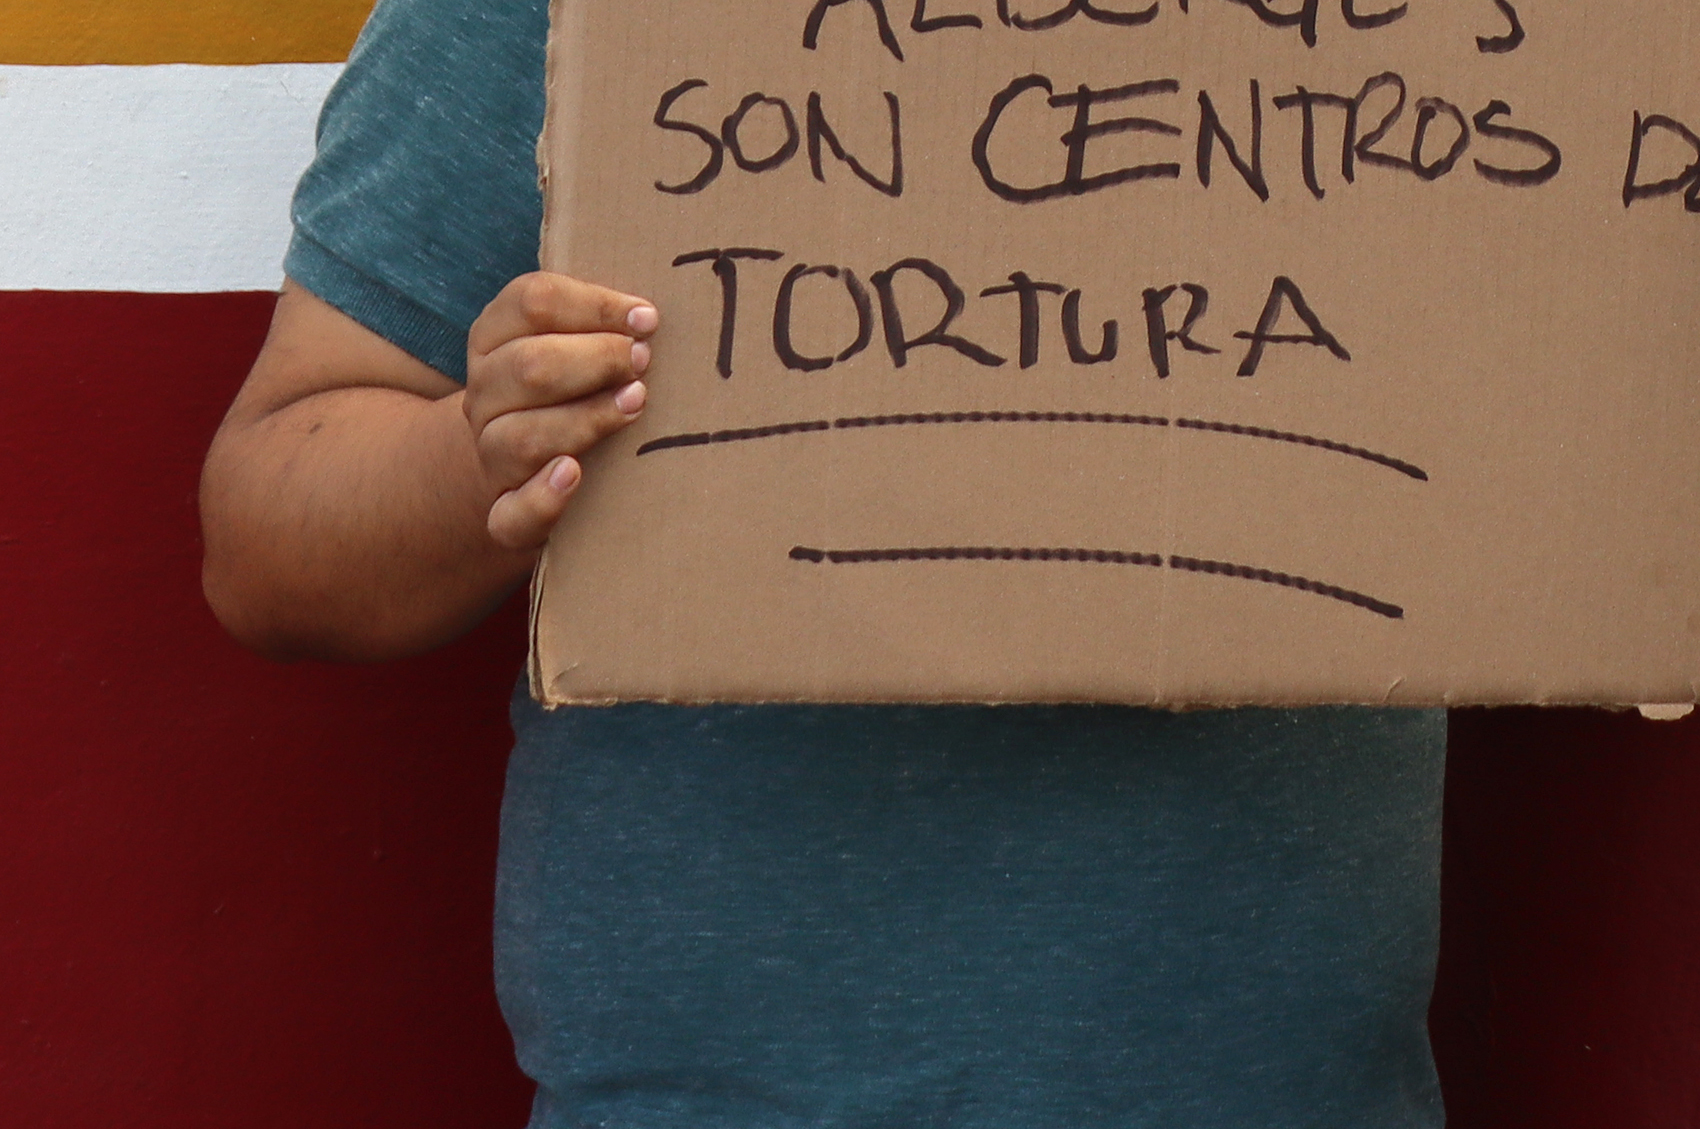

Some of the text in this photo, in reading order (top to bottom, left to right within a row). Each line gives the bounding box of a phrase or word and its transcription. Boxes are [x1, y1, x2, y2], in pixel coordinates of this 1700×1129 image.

[654, 79, 903, 197] SON
[971, 71, 1562, 205] CENTROS
[672, 247, 1351, 379] TORTURA
